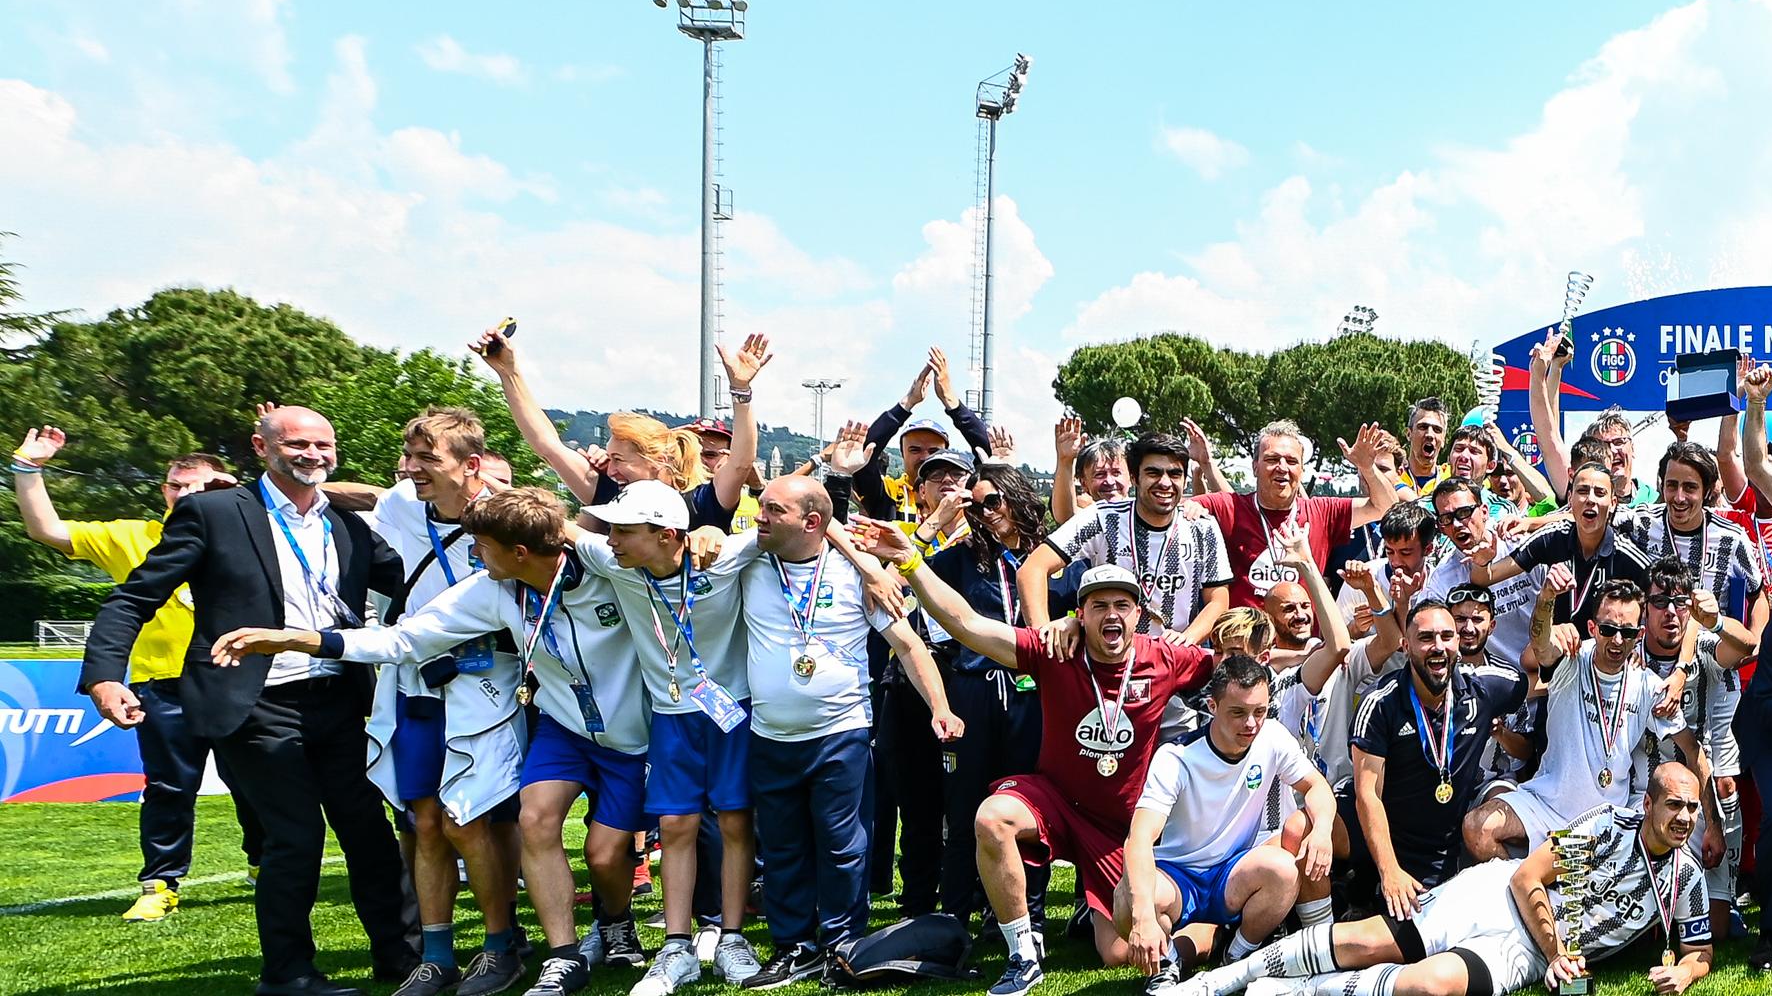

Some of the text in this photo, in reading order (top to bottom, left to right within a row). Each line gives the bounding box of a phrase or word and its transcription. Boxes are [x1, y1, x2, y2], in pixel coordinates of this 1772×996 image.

[1660, 325, 1753, 354] FINALE
[1601, 354, 1625, 366] FIGC
[1520, 444, 1538, 453] FIGC
[1251, 564, 1297, 582] aido
[1139, 572, 1187, 594] eep
[1497, 586, 1510, 599] FOR
[479, 677, 502, 700] fast
[1079, 747, 1125, 760] piemnte
[1589, 877, 1645, 922] Jeep
